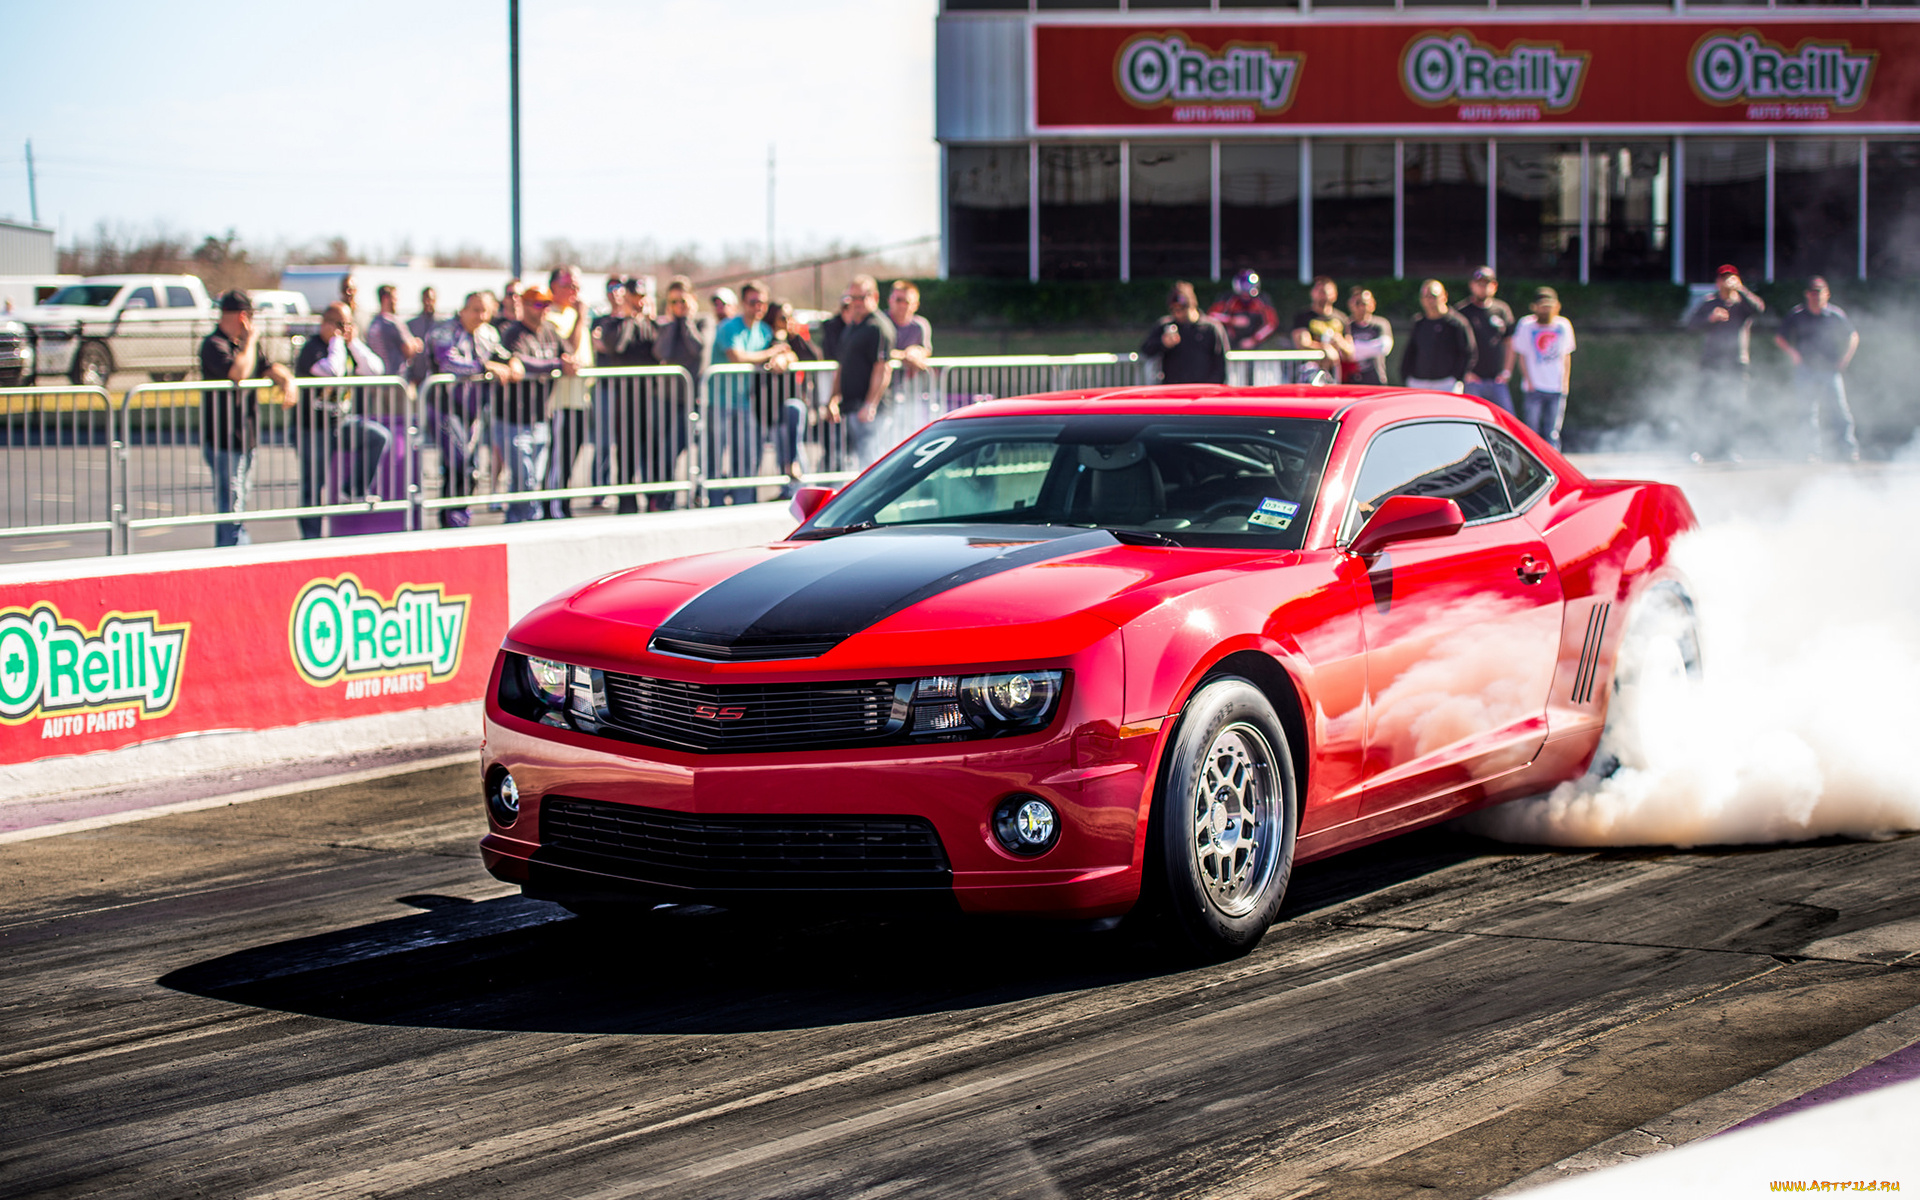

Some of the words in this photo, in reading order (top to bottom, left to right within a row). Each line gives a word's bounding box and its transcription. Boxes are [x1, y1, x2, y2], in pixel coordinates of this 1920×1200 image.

[1128, 42, 1293, 100] O'Reilly
[1413, 41, 1580, 99] O'Reilly
[1701, 40, 1868, 98] O'Reilly
[913, 435, 957, 468] 9
[302, 591, 458, 669] O'Reilly
[0, 620, 174, 707] O'Reilly
[345, 679, 382, 700] AUTO
[383, 672, 425, 695] PARTS
[41, 714, 84, 740] AUTO
[86, 708, 136, 734] PARTS
[694, 704, 747, 720] SS
